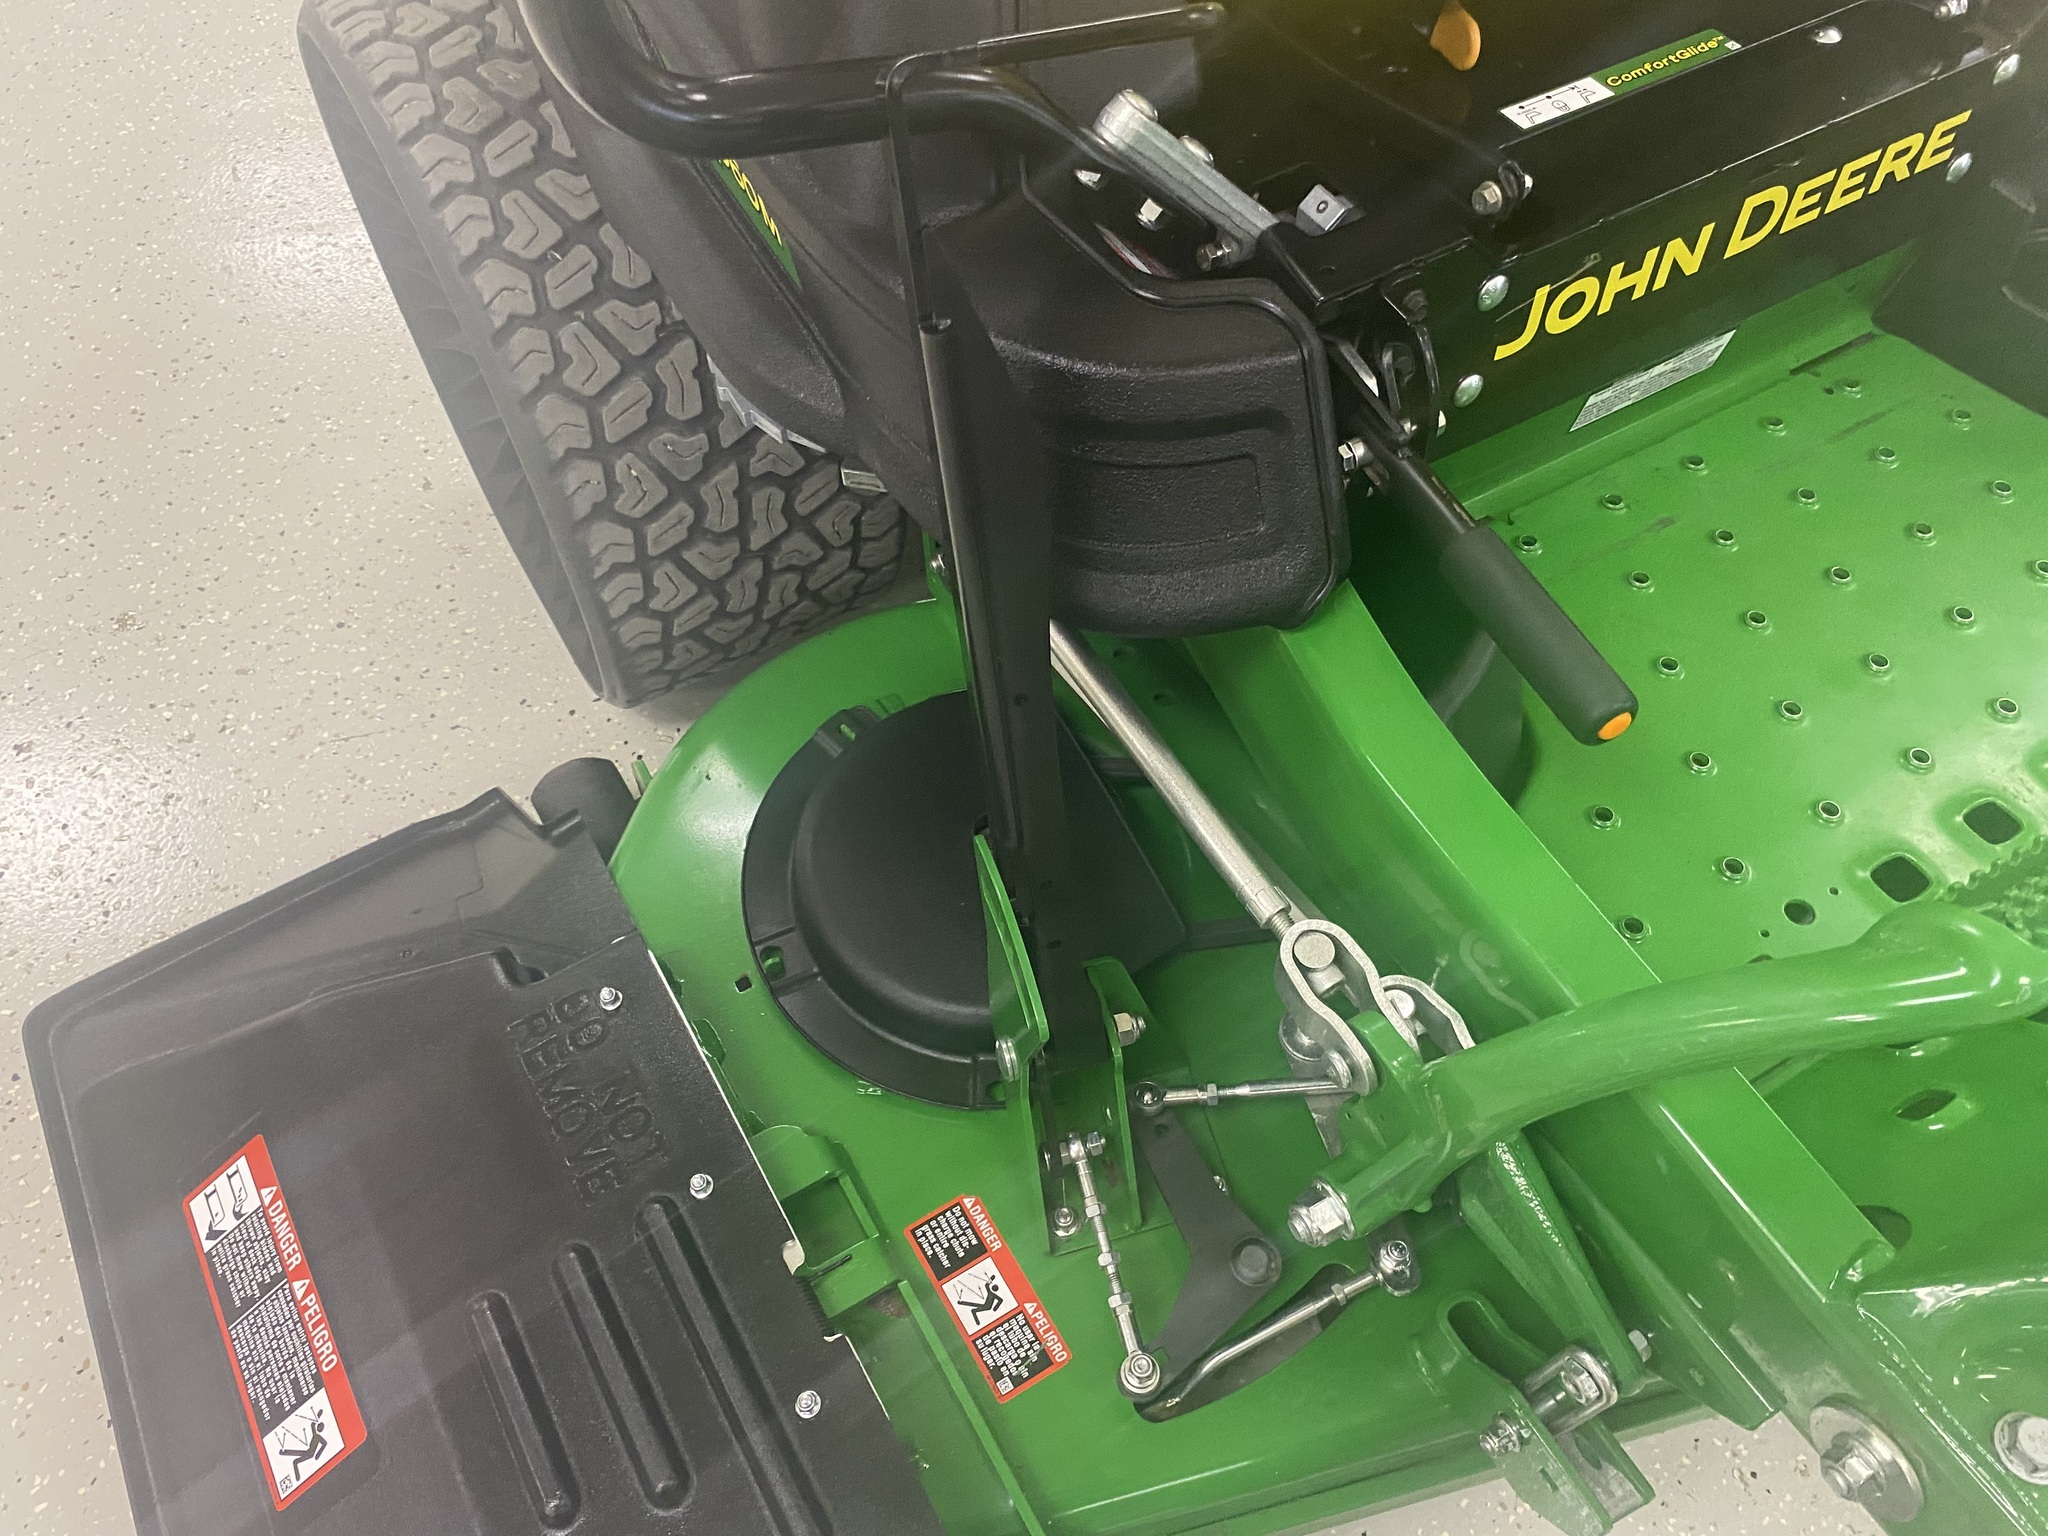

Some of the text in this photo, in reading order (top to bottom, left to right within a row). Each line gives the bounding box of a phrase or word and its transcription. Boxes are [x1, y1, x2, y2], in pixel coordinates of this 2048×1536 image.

[1493, 109, 1973, 362] JOHN DEERE
[548, 988, 669, 1168] DO NOT
[506, 1009, 625, 1207] REMOVE
[268, 1199, 302, 1271] DANGER
[914, 1226, 934, 1259] in place.
[929, 1219, 950, 1249] or entire
[936, 1214, 965, 1258] charge chute
[944, 1209, 970, 1249] without dis-
[951, 1205, 979, 1245] Do not mow
[969, 1204, 1002, 1252] DANGER
[920, 1223, 951, 1268] grass catcher
[300, 1293, 337, 1372] PELIGRO
[981, 1334, 992, 1346] de
[988, 1330, 999, 1340] el
[993, 1326, 1018, 1361] descarga
[1002, 1321, 1027, 1358] el tubo de
[1015, 1312, 1041, 1351] No usar la
[1030, 1310, 1068, 1362] PELIGRO
[975, 1338, 985, 1349] su
[980, 1346, 996, 1370] lugar.
[986, 1344, 1004, 1366] pasto
[993, 1338, 1019, 1376] recogedor
[999, 1365, 1010, 1377] en
[1014, 1358, 1022, 1366] o
[1017, 1363, 1029, 1379] sin
[1026, 1348, 1038, 1363] sin
